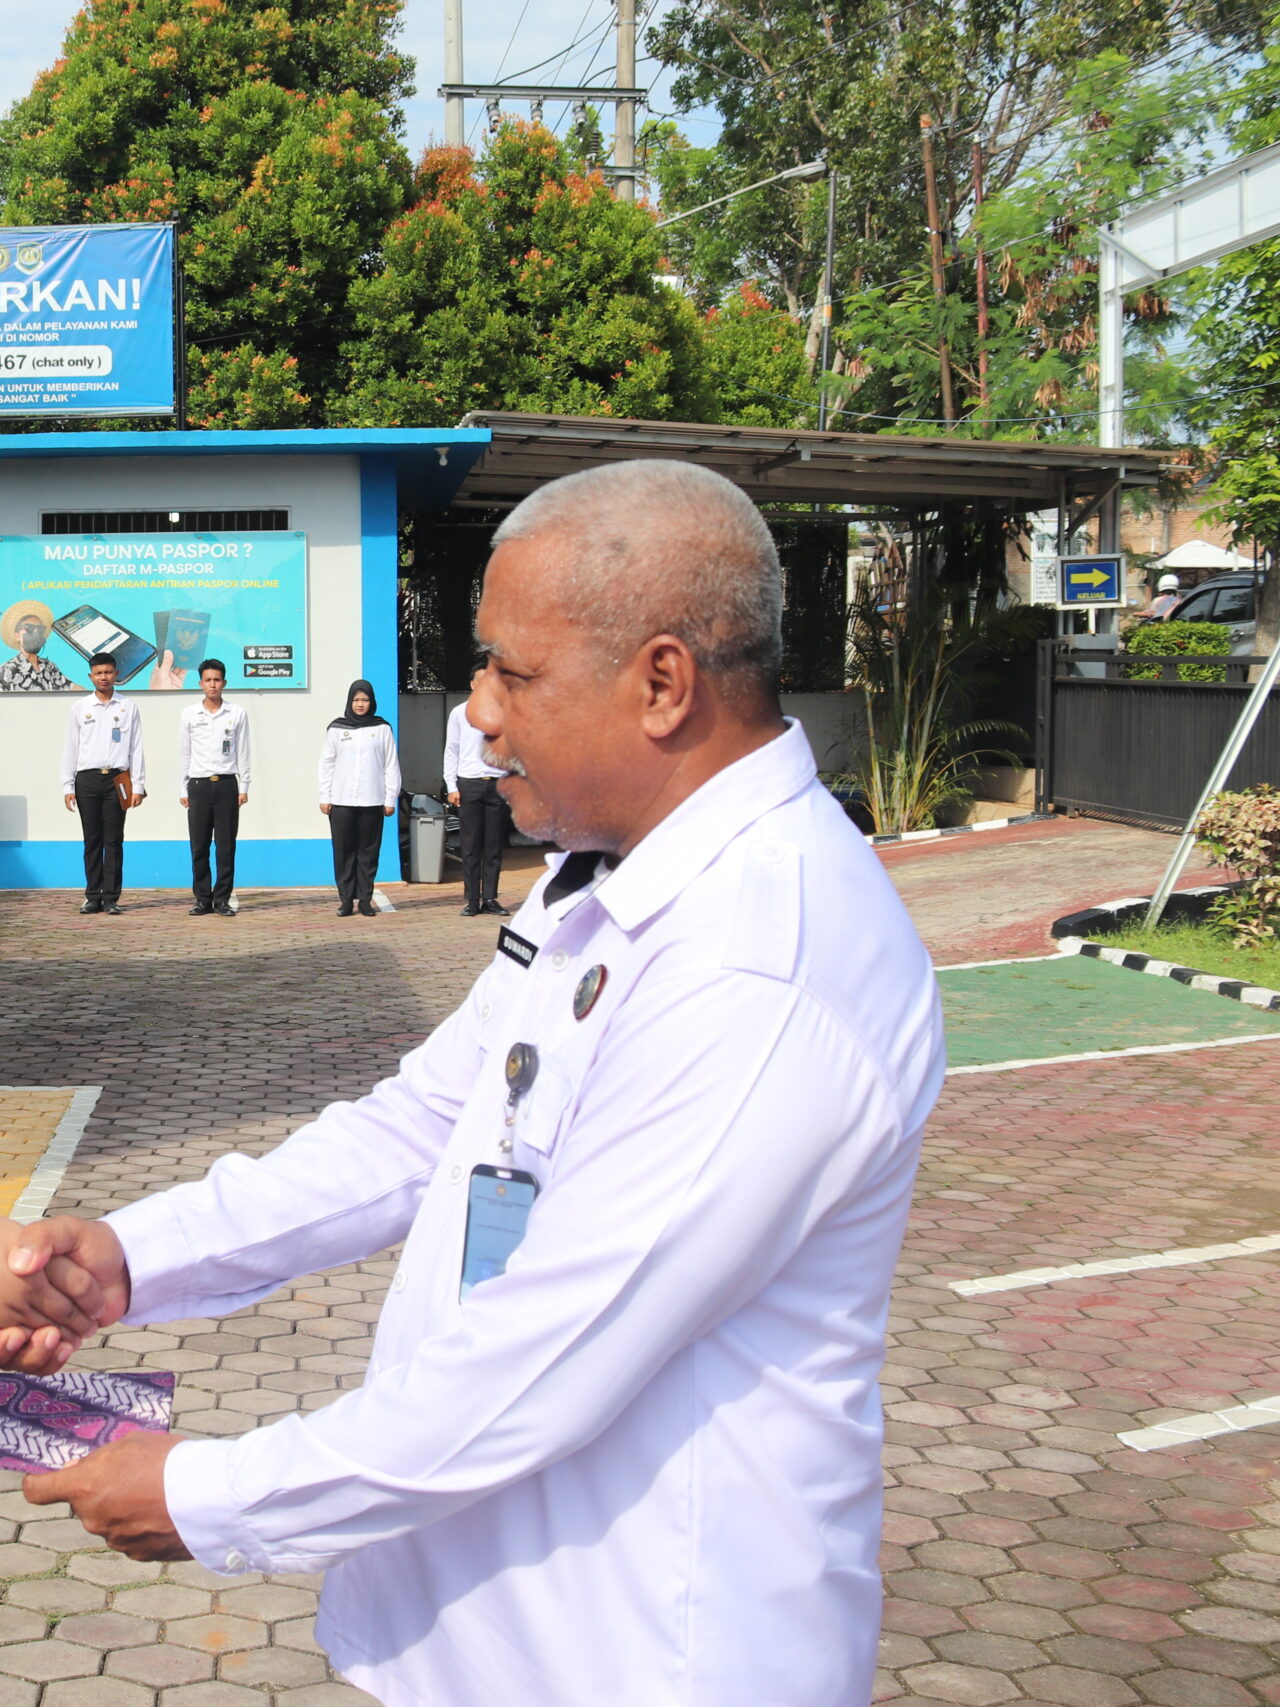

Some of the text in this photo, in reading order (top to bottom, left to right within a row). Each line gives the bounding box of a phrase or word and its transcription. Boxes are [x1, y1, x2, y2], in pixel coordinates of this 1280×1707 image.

[4, 323, 41, 332] DALAM
[44, 321, 108, 331] PELAYANAN
[110, 320, 138, 329] KAMI
[6, 333, 16, 342] DI
[19, 333, 60, 342] NOMOR
[32, 357, 65, 369] (chat
[67, 356, 94, 369] only
[7, 383, 44, 393] UNTUK
[47, 382, 119, 392] MEMBERIKAN
[42, 393, 68, 403] BAIK
[44, 543, 253, 560] MAU PUNYA PASPOR ?
[83, 562, 214, 576] DAFTAR M-PASPOR
[28, 580, 72, 590] APLIKASI
[74, 579, 147, 589] PENDAFTARAN
[150, 579, 195, 588] ANTRIAN
[197, 579, 238, 589] PASPOR
[240, 578, 280, 588] ONLINE
[258, 651, 271, 659] App
[258, 668, 291, 677] Google Play
